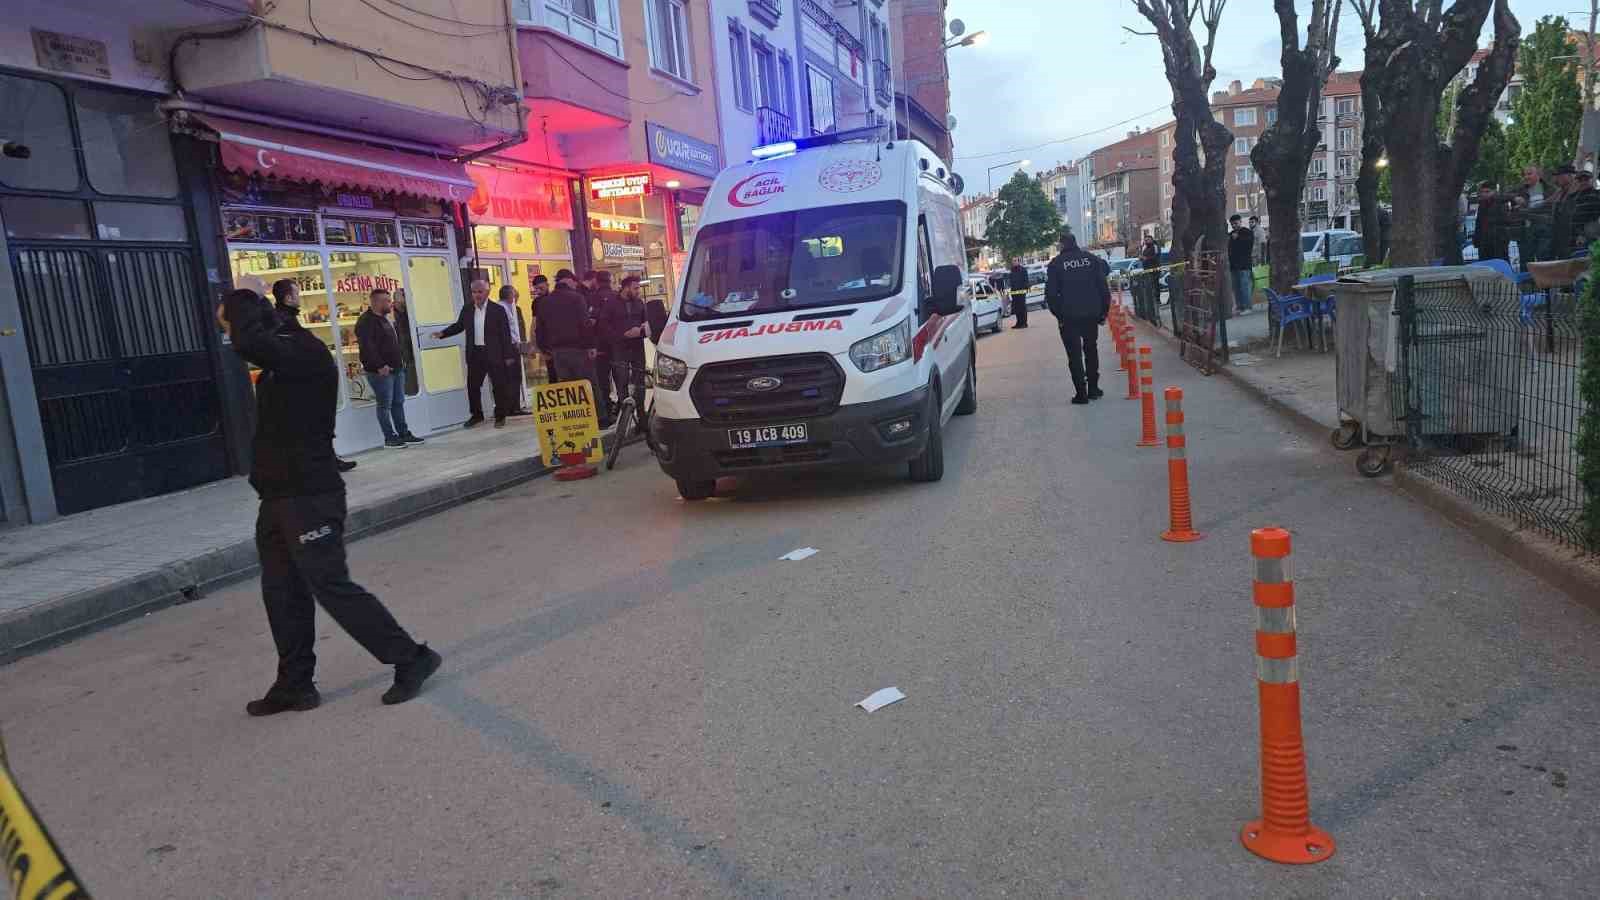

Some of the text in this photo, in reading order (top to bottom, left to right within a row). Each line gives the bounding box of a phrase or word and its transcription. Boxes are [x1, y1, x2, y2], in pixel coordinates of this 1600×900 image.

[336, 275, 373, 292] ASENA
[536, 385, 591, 412] ASENA
[737, 425, 806, 444] 19 ACB 409
